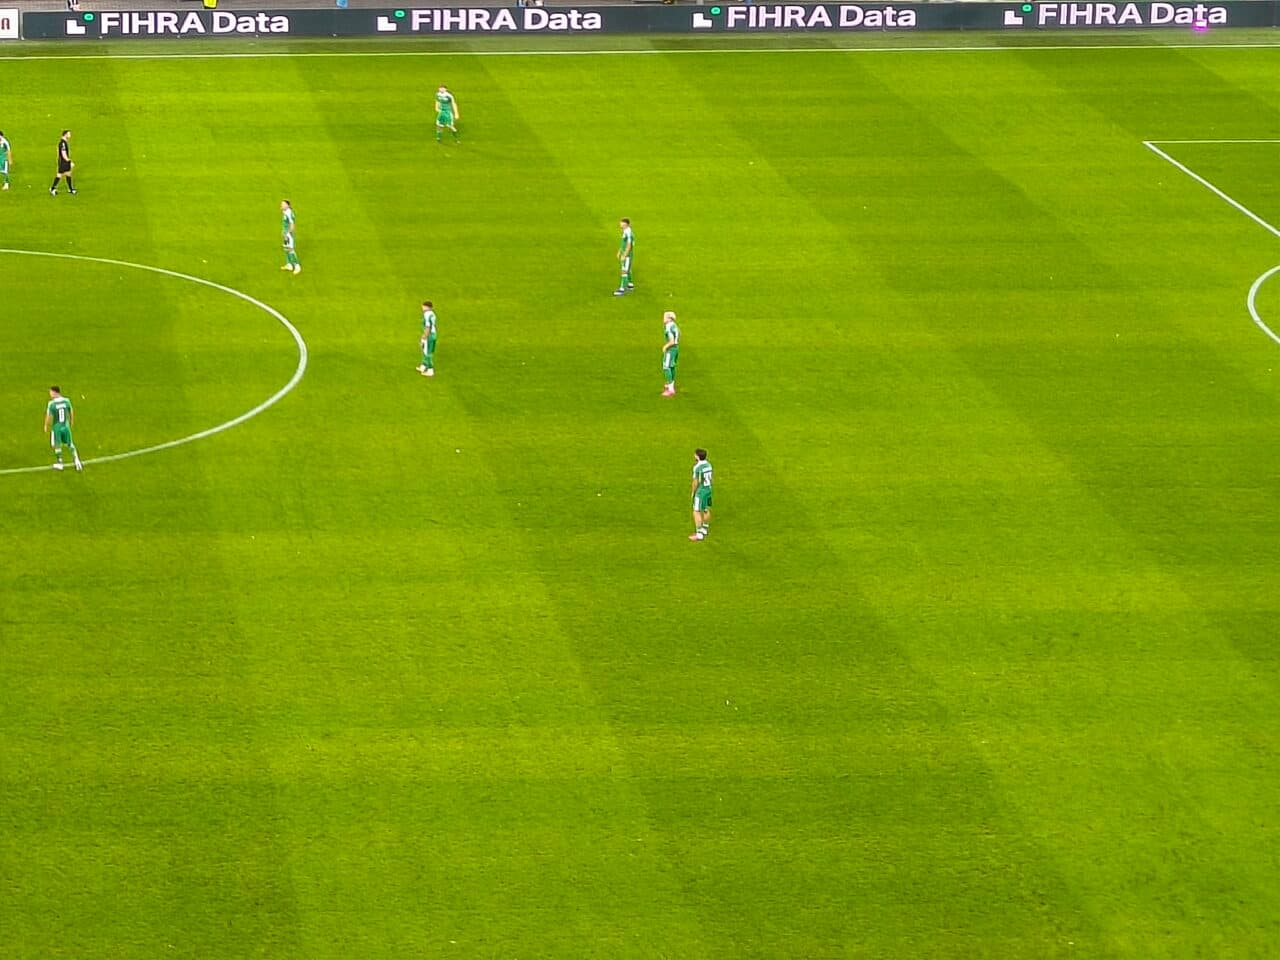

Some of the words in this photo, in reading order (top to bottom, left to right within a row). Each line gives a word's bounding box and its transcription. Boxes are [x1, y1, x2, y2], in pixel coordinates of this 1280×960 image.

[101, 12, 205, 33] FIHRA
[212, 11, 289, 32] Data
[411, 8, 517, 30] FIHRA
[524, 8, 602, 29] Data
[727, 6, 832, 27] FIHRA
[839, 5, 916, 26] Data
[1038, 3, 1143, 24] FIHRA
[1150, 3, 1226, 24] Data
